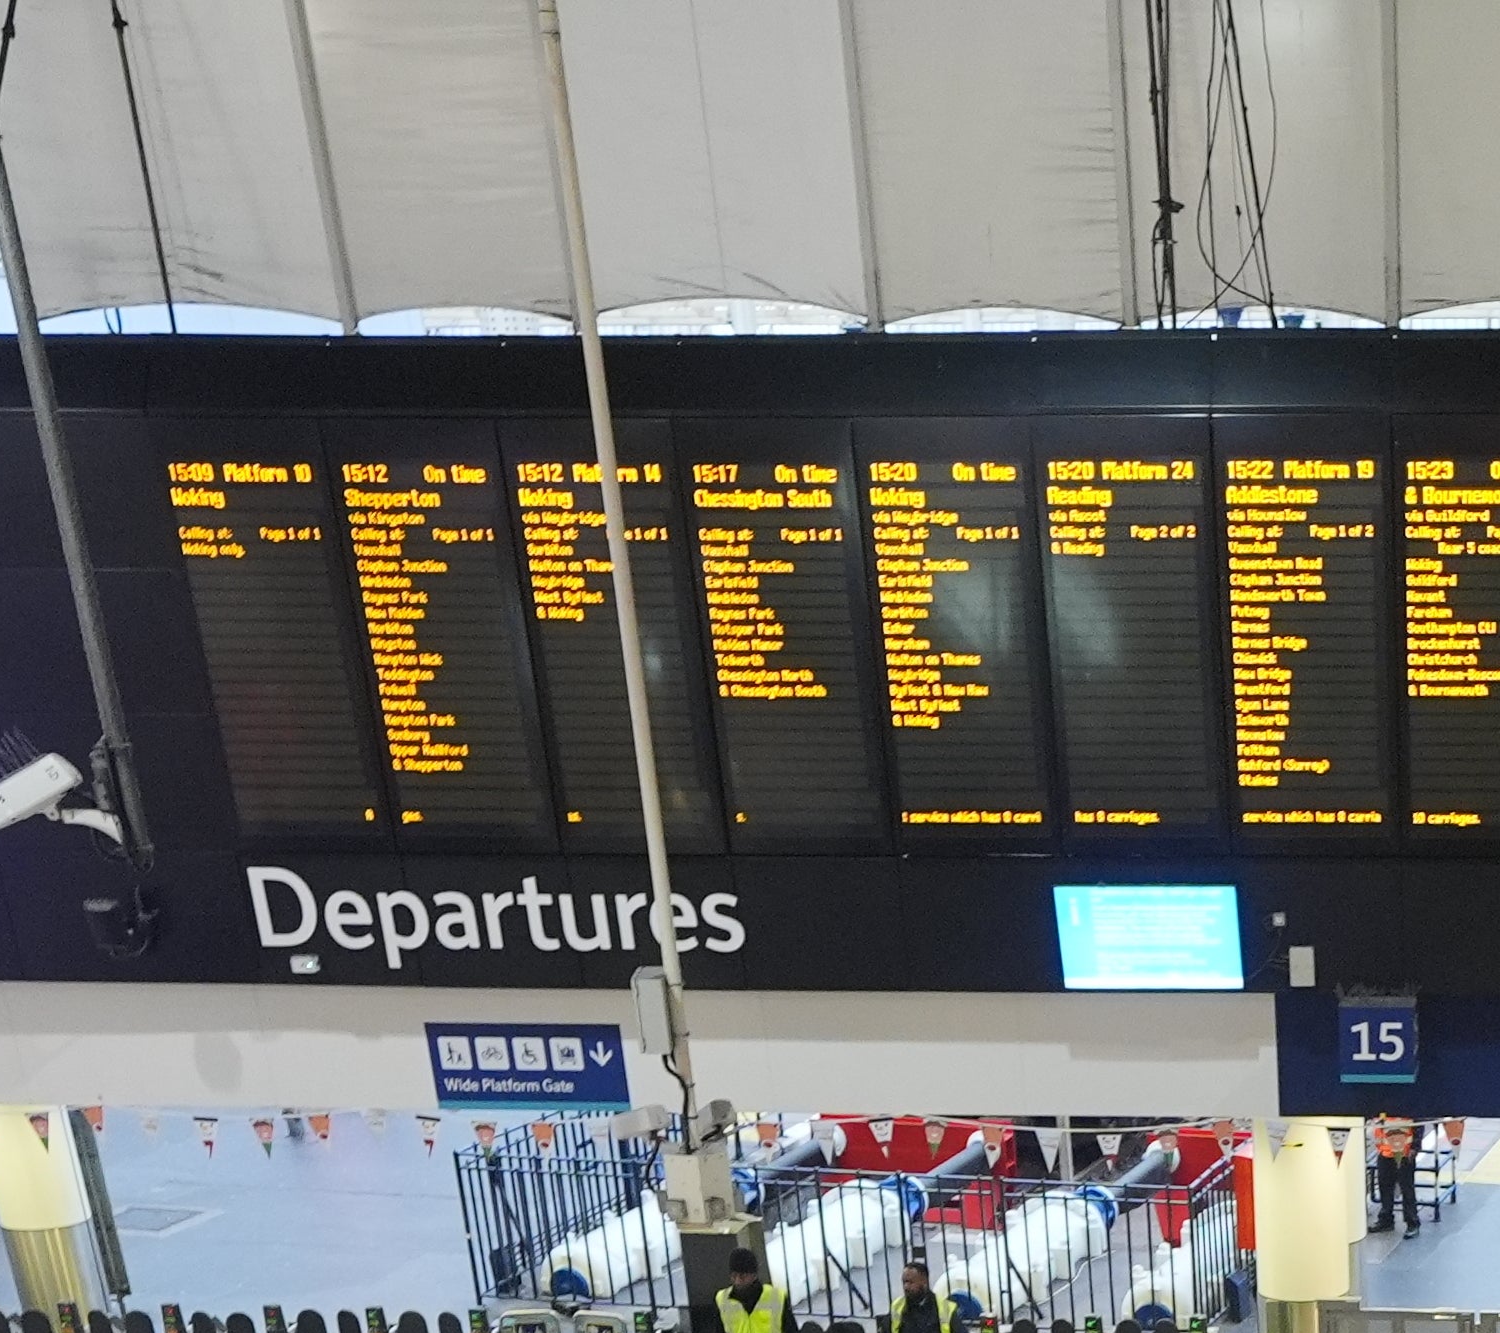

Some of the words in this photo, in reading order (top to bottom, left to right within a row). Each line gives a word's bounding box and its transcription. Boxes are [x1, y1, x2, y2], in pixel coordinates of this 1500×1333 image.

[168, 463, 214, 482] 15:09
[223, 463, 288, 482] Platform
[293, 464, 311, 482] 10
[342, 464, 388, 482] 15:12
[423, 465, 446, 483] On
[451, 465, 486, 483] time
[518, 463, 564, 482] 15:12
[572, 463, 638, 482] Platrm
[644, 464, 661, 482] 14
[693, 465, 738, 483] 15:17
[775, 465, 797, 483] On
[802, 465, 837, 483] time
[870, 463, 917, 481] 15:20
[952, 463, 976, 481] On
[980, 463, 1016, 481] time
[1048, 461, 1095, 480] 15:20
[1101, 461, 1168, 480] Platform
[1171, 461, 1194, 479] 24
[1227, 460, 1274, 479] 15:22
[1283, 460, 1350, 479] Platform
[1356, 460, 1374, 478] 19
[1407, 461, 1454, 480] 15:23
[170, 487, 225, 508] Woking
[344, 489, 440, 509] Shepperton
[518, 488, 573, 509] Woking
[694, 489, 781, 510] Chessington
[787, 489, 832, 507] South
[870, 487, 925, 508] Woking
[1047, 486, 1112, 507] Reading
[1226, 485, 1318, 504] Addlestone
[1405, 486, 1418, 504] &
[246, 865, 746, 969] Departures
[1349, 1021, 1406, 1062] 15
[444, 1078, 480, 1093] Wide
[482, 1078, 540, 1093] Platform
[542, 1079, 574, 1094] Gate
